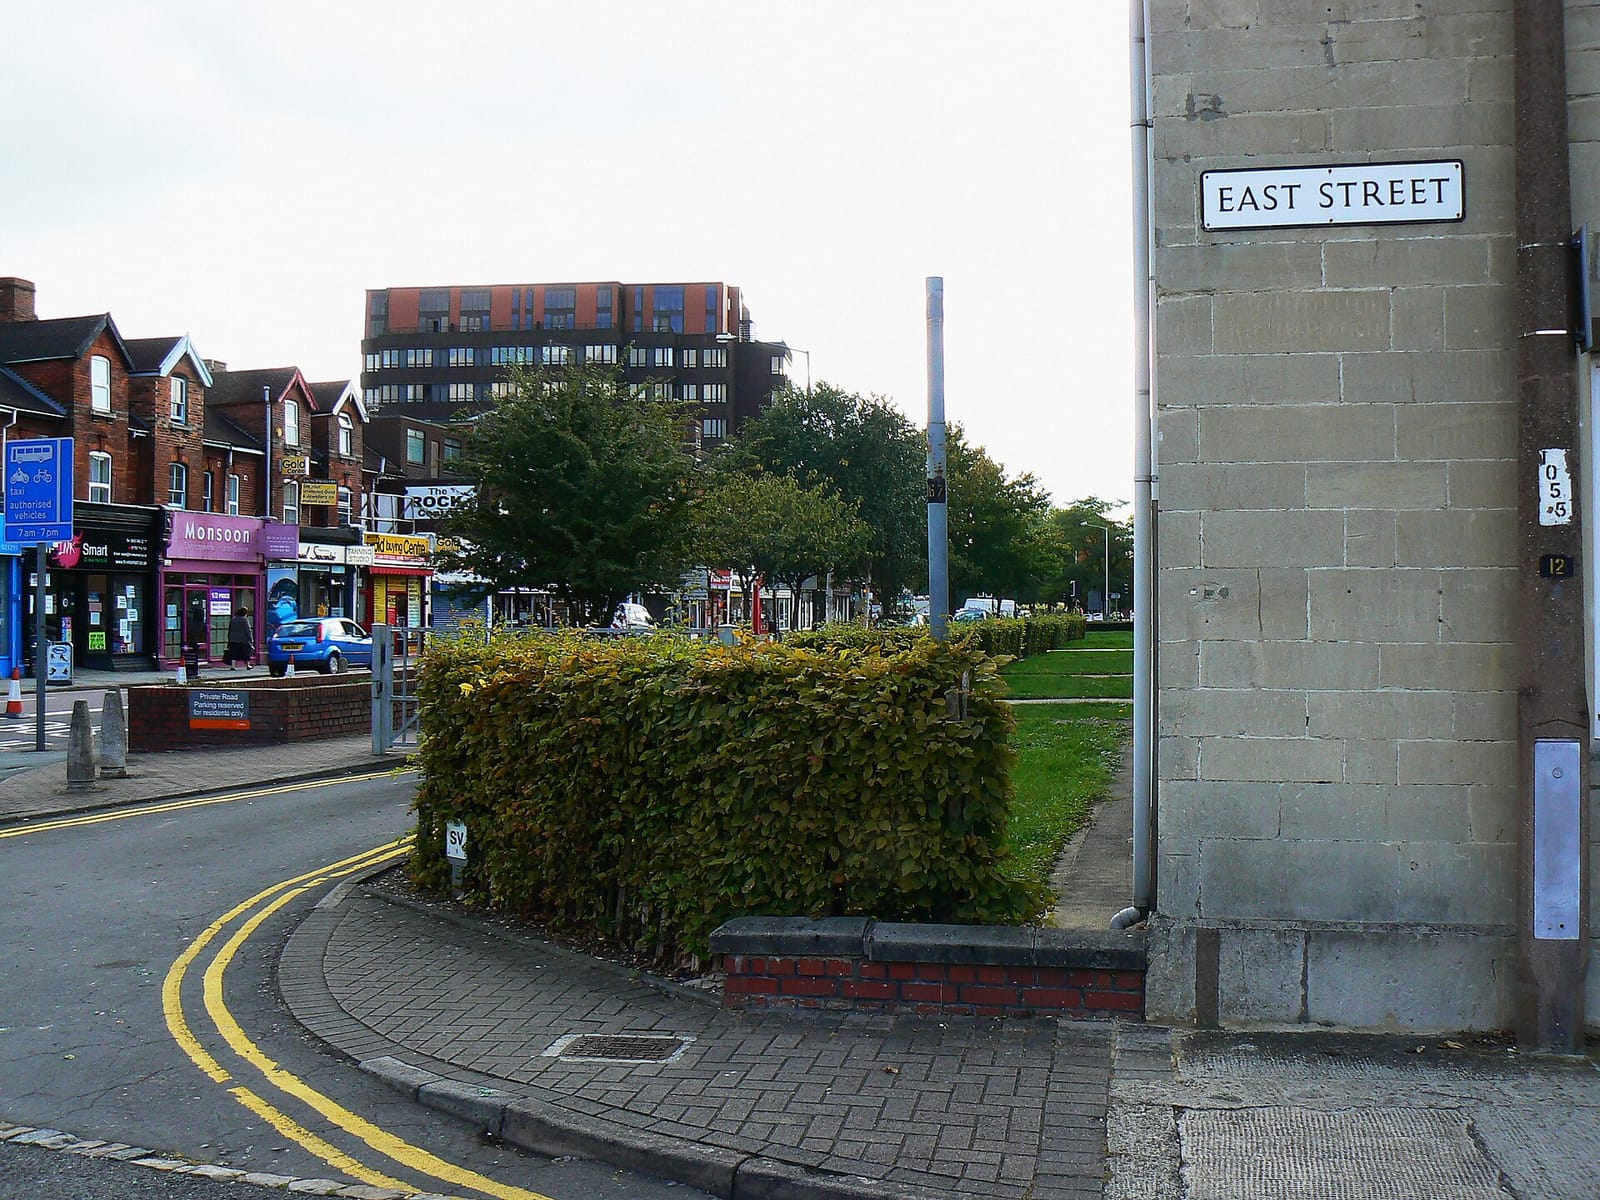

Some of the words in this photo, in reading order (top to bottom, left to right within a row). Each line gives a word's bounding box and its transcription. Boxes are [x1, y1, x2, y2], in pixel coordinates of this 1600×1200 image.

[1217, 183, 1302, 213] EAST
[1318, 177, 1451, 208] STREET
[10, 487, 25, 496] taxi
[429, 487, 448, 495] The
[10, 500, 52, 510] authorised
[14, 511, 47, 520] vehicles
[184, 521, 251, 544] Monsoon
[82, 542, 109, 557] Smart
[1549, 558, 1566, 575] 12
[199, 692, 221, 700] Private
[193, 701, 217, 709] Parking
[450, 830, 464, 846] SV
